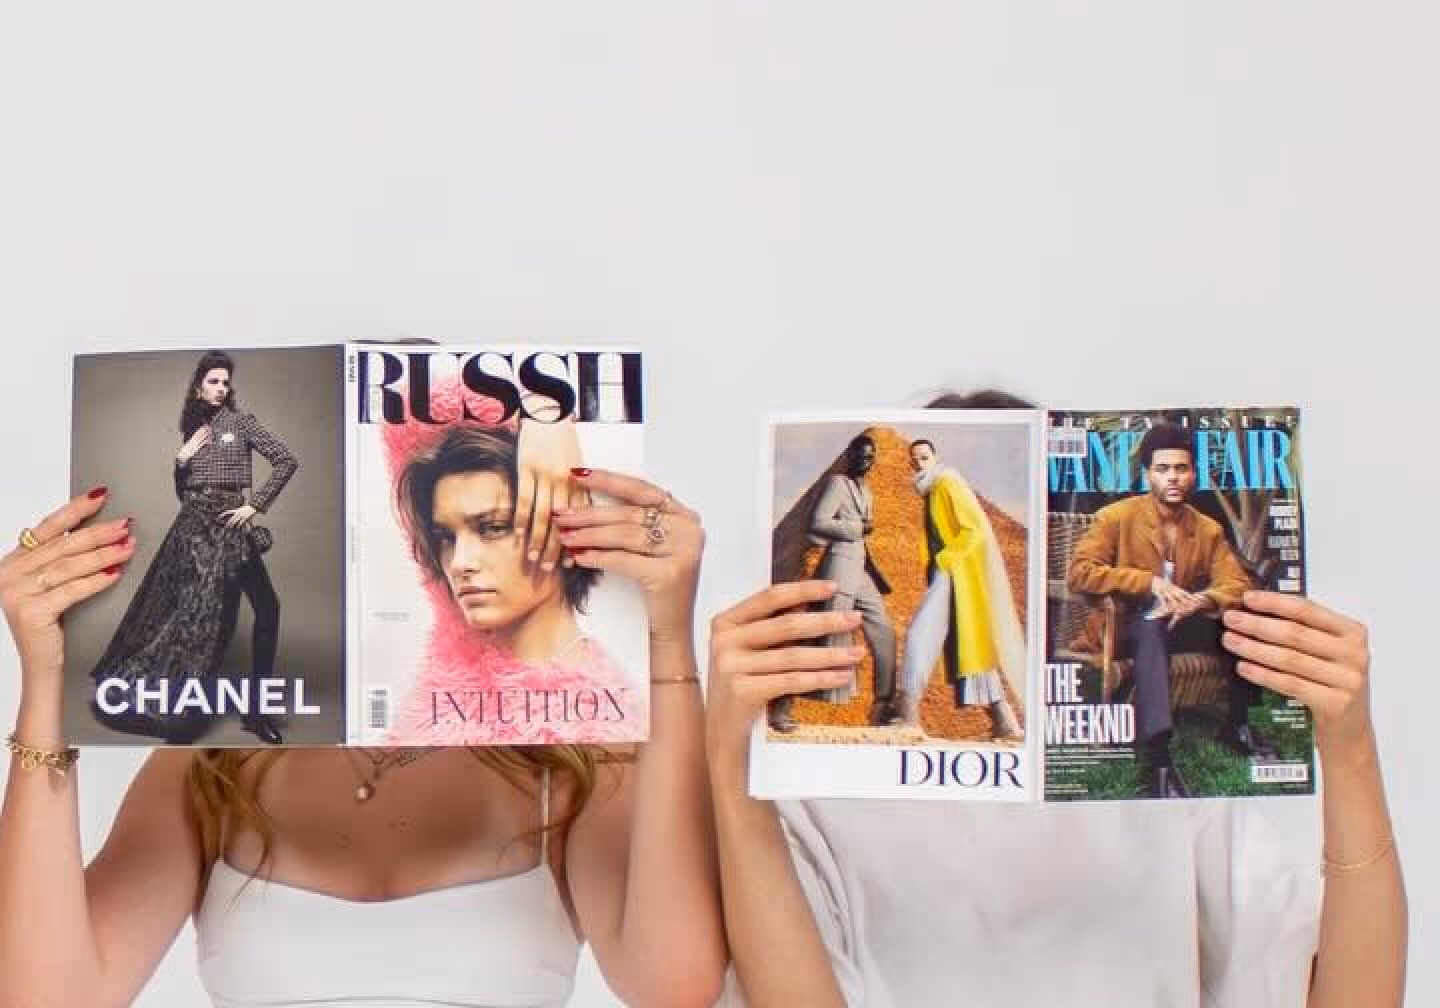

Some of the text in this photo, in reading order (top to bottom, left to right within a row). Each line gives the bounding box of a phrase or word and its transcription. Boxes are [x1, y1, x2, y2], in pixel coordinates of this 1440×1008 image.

[357, 351, 643, 424] RUSSH
[1196, 430, 1295, 491] FAIR
[96, 681, 321, 715] CHANEL
[1045, 664, 1084, 703] THE
[431, 688, 626, 724] INTUITION
[1045, 703, 1136, 745] WEEKND
[896, 749, 1025, 788] DIOR
